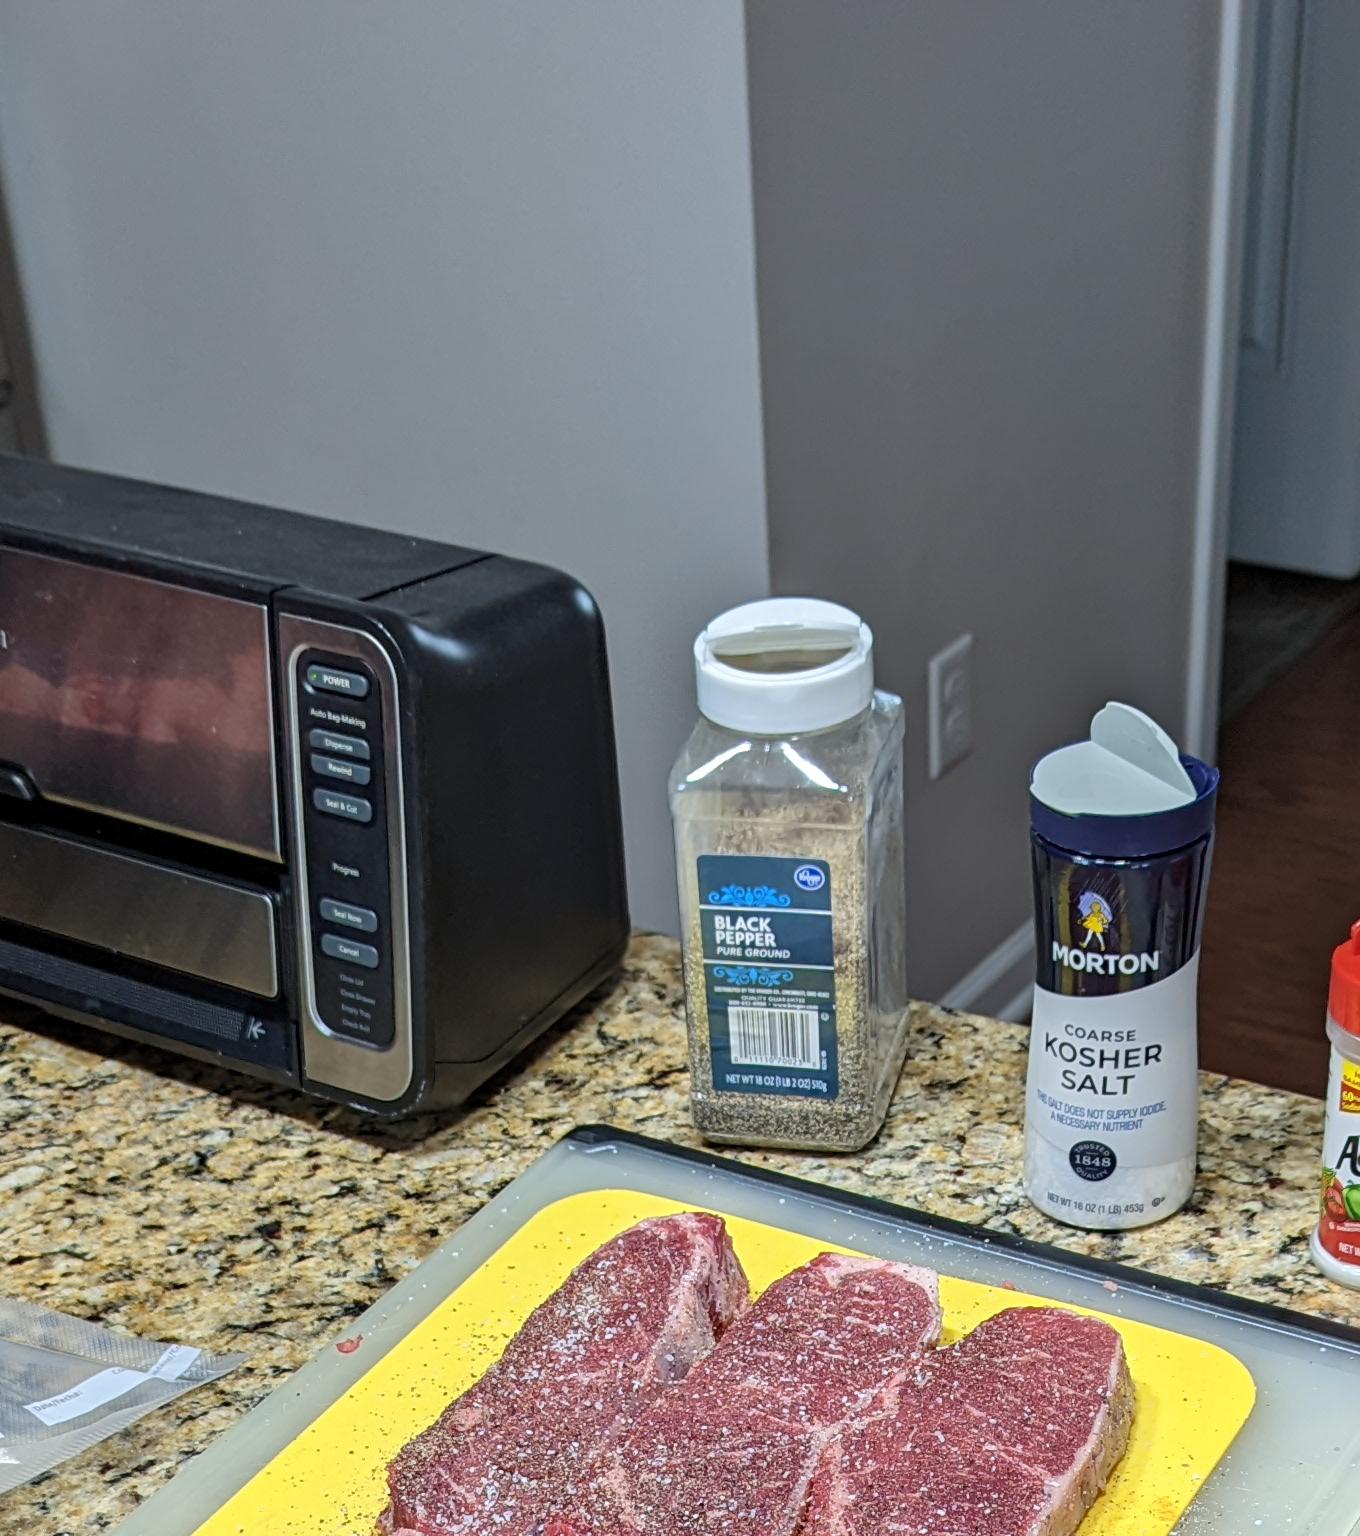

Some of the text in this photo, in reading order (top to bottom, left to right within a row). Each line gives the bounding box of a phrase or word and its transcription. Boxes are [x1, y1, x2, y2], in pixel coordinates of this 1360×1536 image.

[323, 674, 350, 688] POWER
[714, 915, 771, 932] BLACK
[715, 931, 776, 947] PEPPER
[717, 947, 790, 959] PURE GROUND
[1052, 941, 1159, 975] MORTON
[1065, 1024, 1136, 1042] COARSE
[1045, 1032, 1162, 1069] KOSHER
[726, 1074, 740, 1084] NET
[742, 1075, 754, 1084] WT
[764, 1076, 774, 1087] OZ
[782, 1077, 791, 1088] LB
[792, 1078, 797, 1088] 2
[798, 1078, 810, 1090] OZ)
[812, 1080, 827, 1093] 510g
[1061, 1069, 1135, 1096] SALT
[1048, 1096, 1062, 1111] SALT
[1065, 1103, 1085, 1118] DOES
[1087, 1108, 1104, 1120] NOT
[1107, 1108, 1138, 1120] SUPPLY
[1057, 1113, 1101, 1131] NECESSARY
[1103, 1119, 1143, 1132] NUTRIENT
[1074, 1144, 1110, 1156] TRUSTED
[1075, 1155, 1111, 1167] 1848
[1076, 1167, 1108, 1179] QUALITY
[1047, 1191, 1059, 1203] NET
[1060, 1197, 1072, 1207] WT
[1073, 1200, 1083, 1211] 16
[1085, 1203, 1096, 1213] OZ
[1108, 1204, 1122, 1215] LB)
[1124, 1203, 1144, 1214] 453g
[1339, 1242, 1353, 1254] NET
